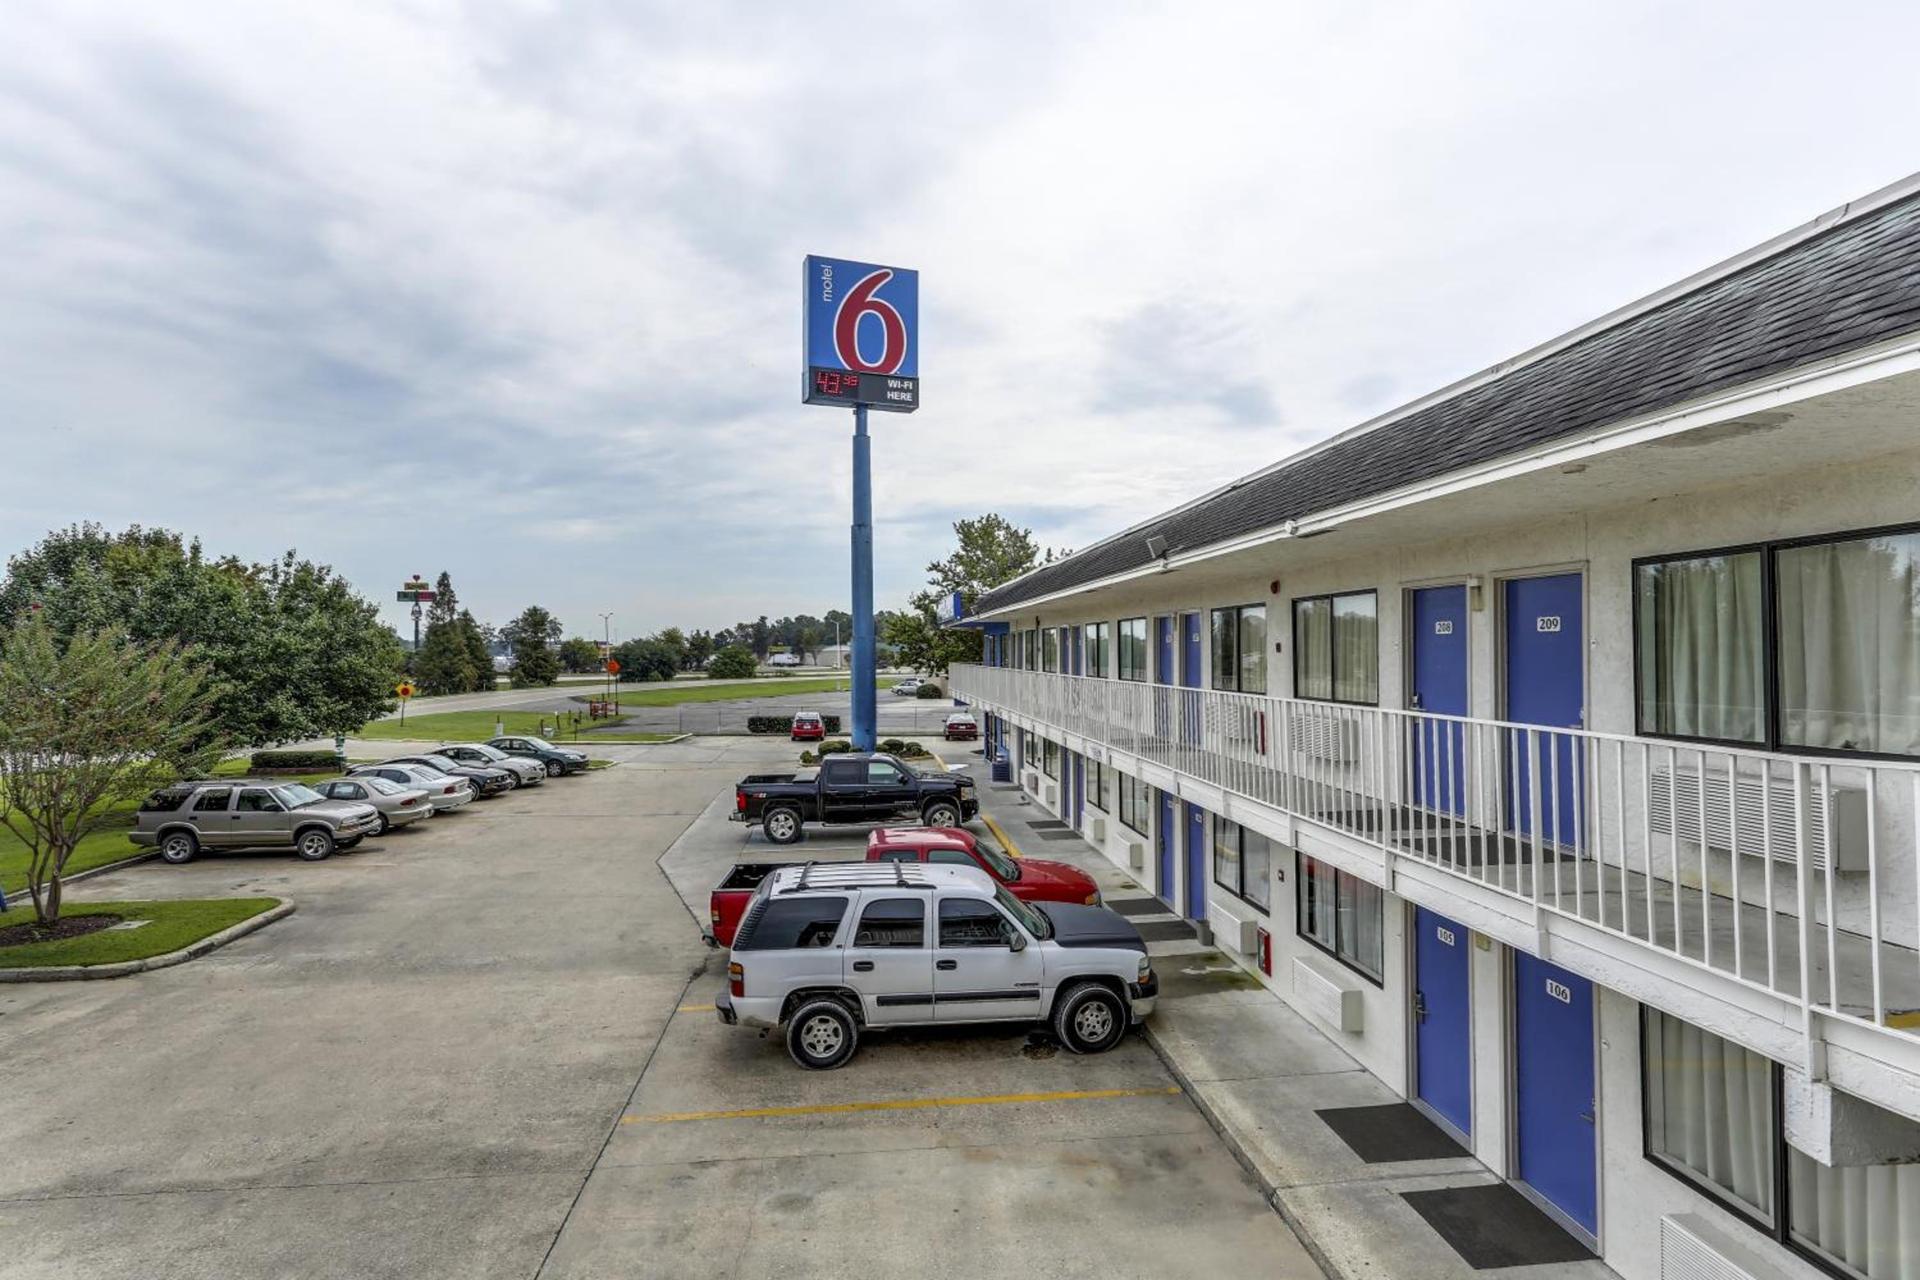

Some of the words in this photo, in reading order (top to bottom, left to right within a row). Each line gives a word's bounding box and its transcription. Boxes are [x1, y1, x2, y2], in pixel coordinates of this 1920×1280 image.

[821, 264, 832, 302] motel
[833, 268, 907, 374] 6
[888, 379, 913, 390] WI-FI
[887, 391, 913, 401] HERE
[1437, 622, 1451, 633] 208
[1539, 618, 1559, 630] 209
[1439, 928, 1453, 943] 105
[1549, 982, 1568, 1001] 106
